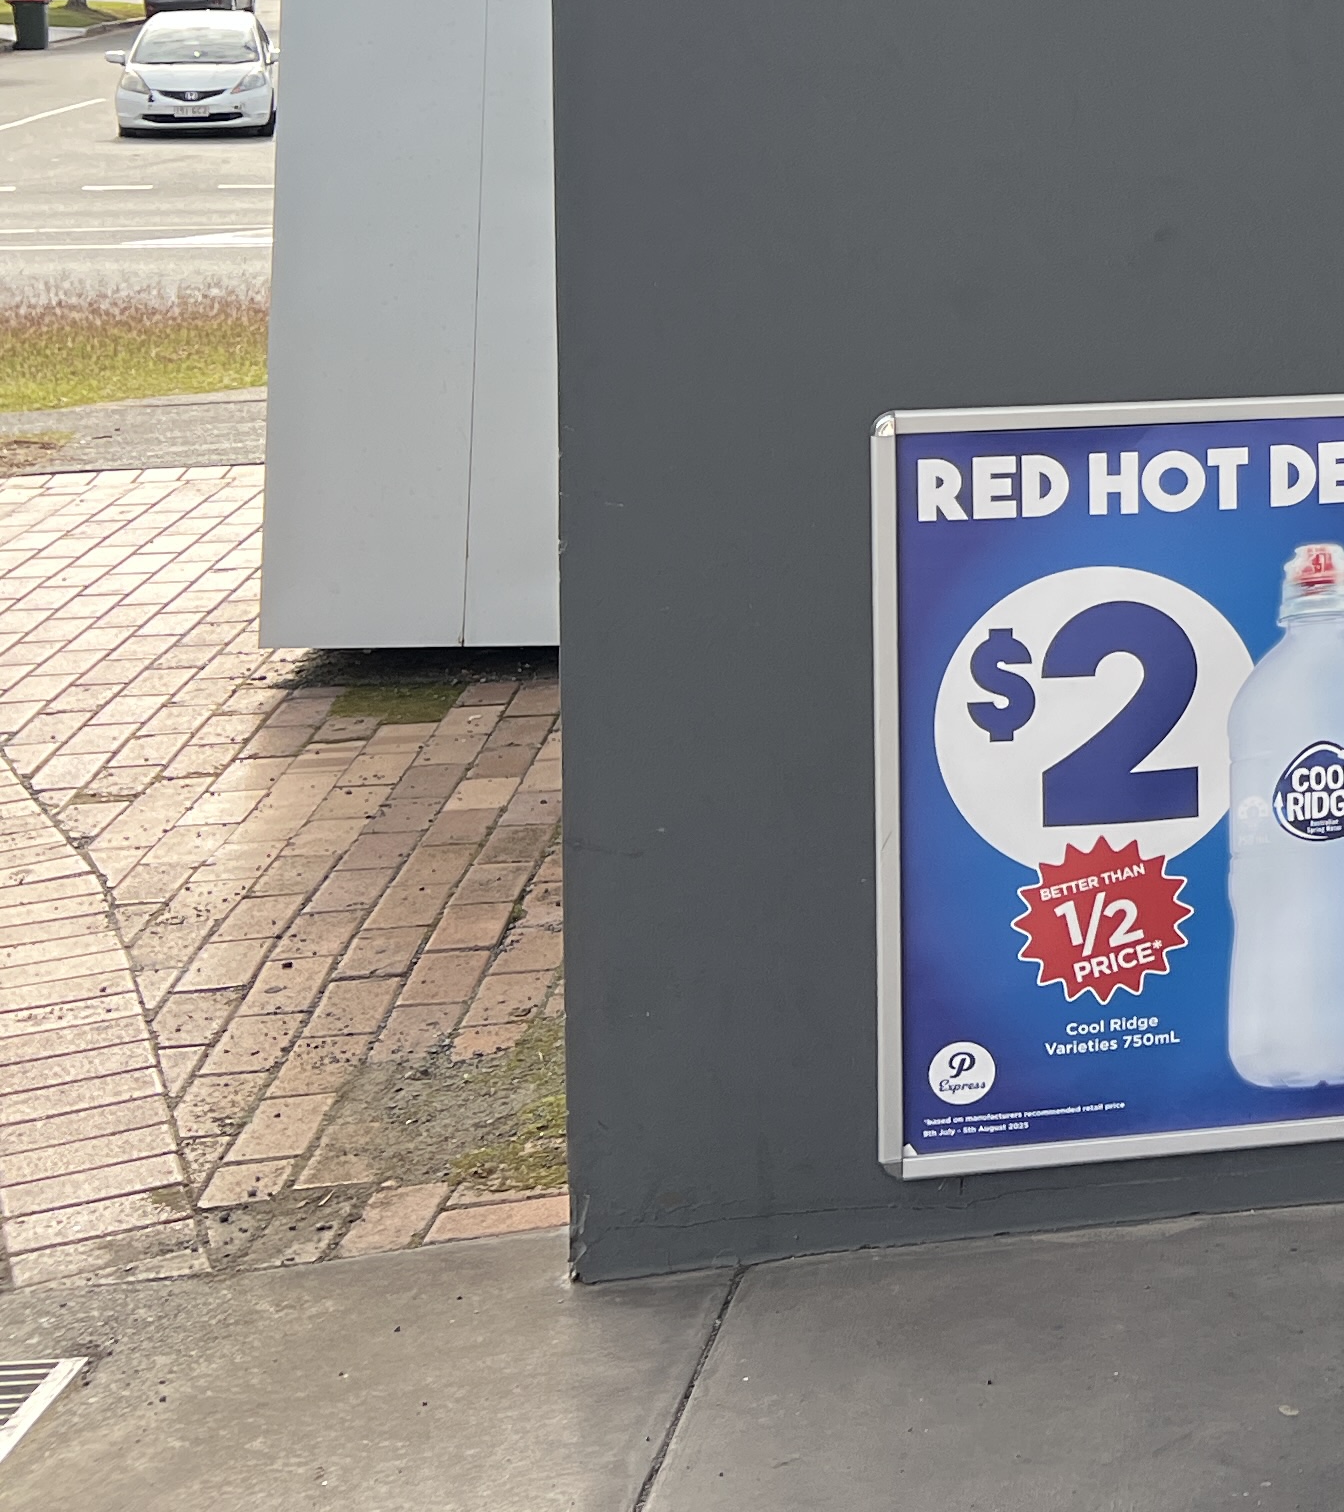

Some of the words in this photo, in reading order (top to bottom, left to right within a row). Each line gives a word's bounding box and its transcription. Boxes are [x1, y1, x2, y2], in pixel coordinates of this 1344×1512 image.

[916, 454, 1070, 522] RED
[1087, 446, 1250, 516] HOT
[966, 600, 1200, 828] $2
[1039, 876, 1100, 902] BETTER
[1100, 863, 1146, 885] THAN
[1053, 891, 1145, 958] 1/2
[1065, 1019, 1105, 1036] Cool
[1109, 1015, 1159, 1033] Ridge
[1044, 1037, 1119, 1056] Varieties
[1122, 1030, 1181, 1049] 750mL
[948, 1051, 976, 1079] P
[938, 1079, 987, 1095] Express
[1023, 1105, 1081, 1118] recommended
[1104, 1101, 1126, 1112] price
